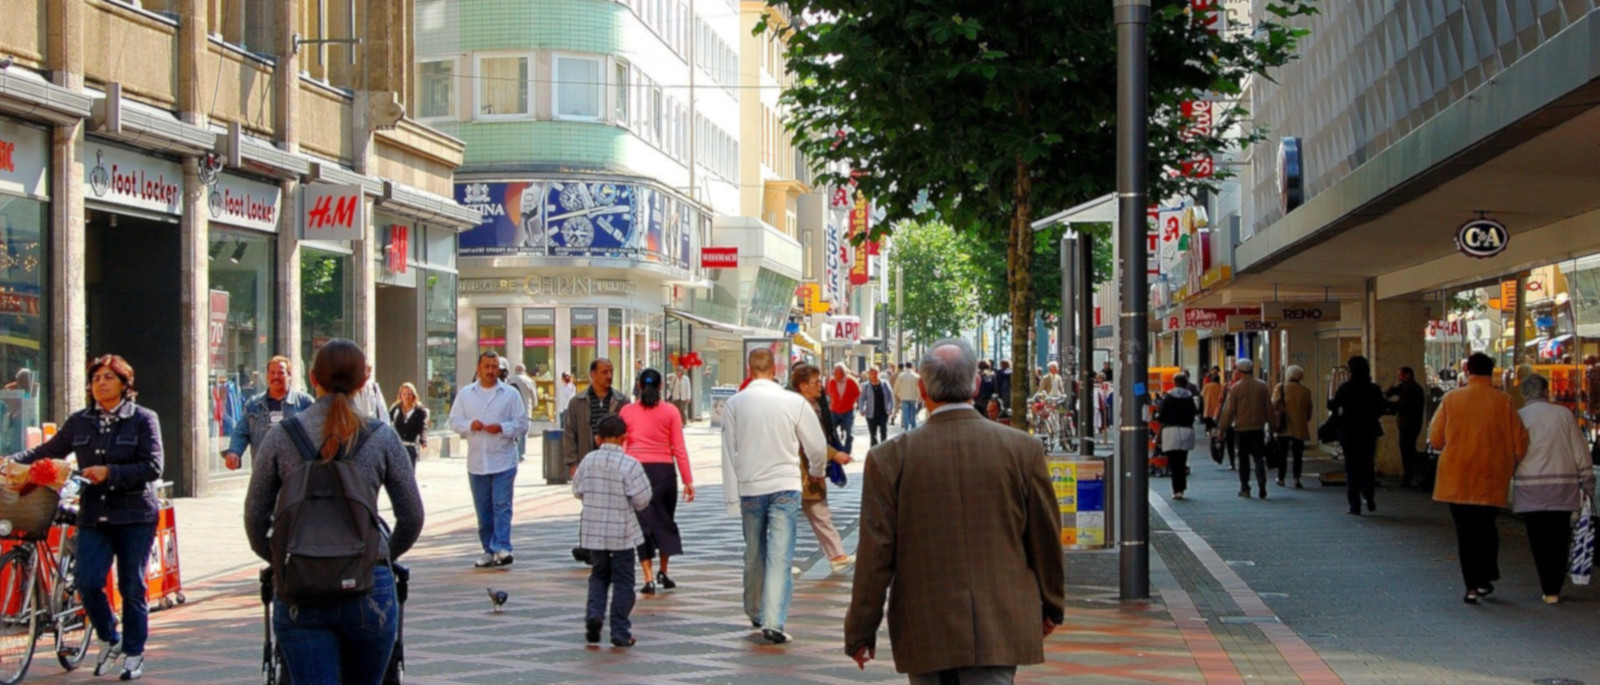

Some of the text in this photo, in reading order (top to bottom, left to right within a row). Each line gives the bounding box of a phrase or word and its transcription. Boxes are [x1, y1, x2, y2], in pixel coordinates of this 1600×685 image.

[112, 164, 177, 205] Foot Locker
[225, 189, 275, 224] Foot Locker
[308, 195, 357, 228] H&M
[1464, 227, 1501, 247] C&A
[1244, 320, 1278, 330] RENO
[1282, 308, 1321, 319] RENO
